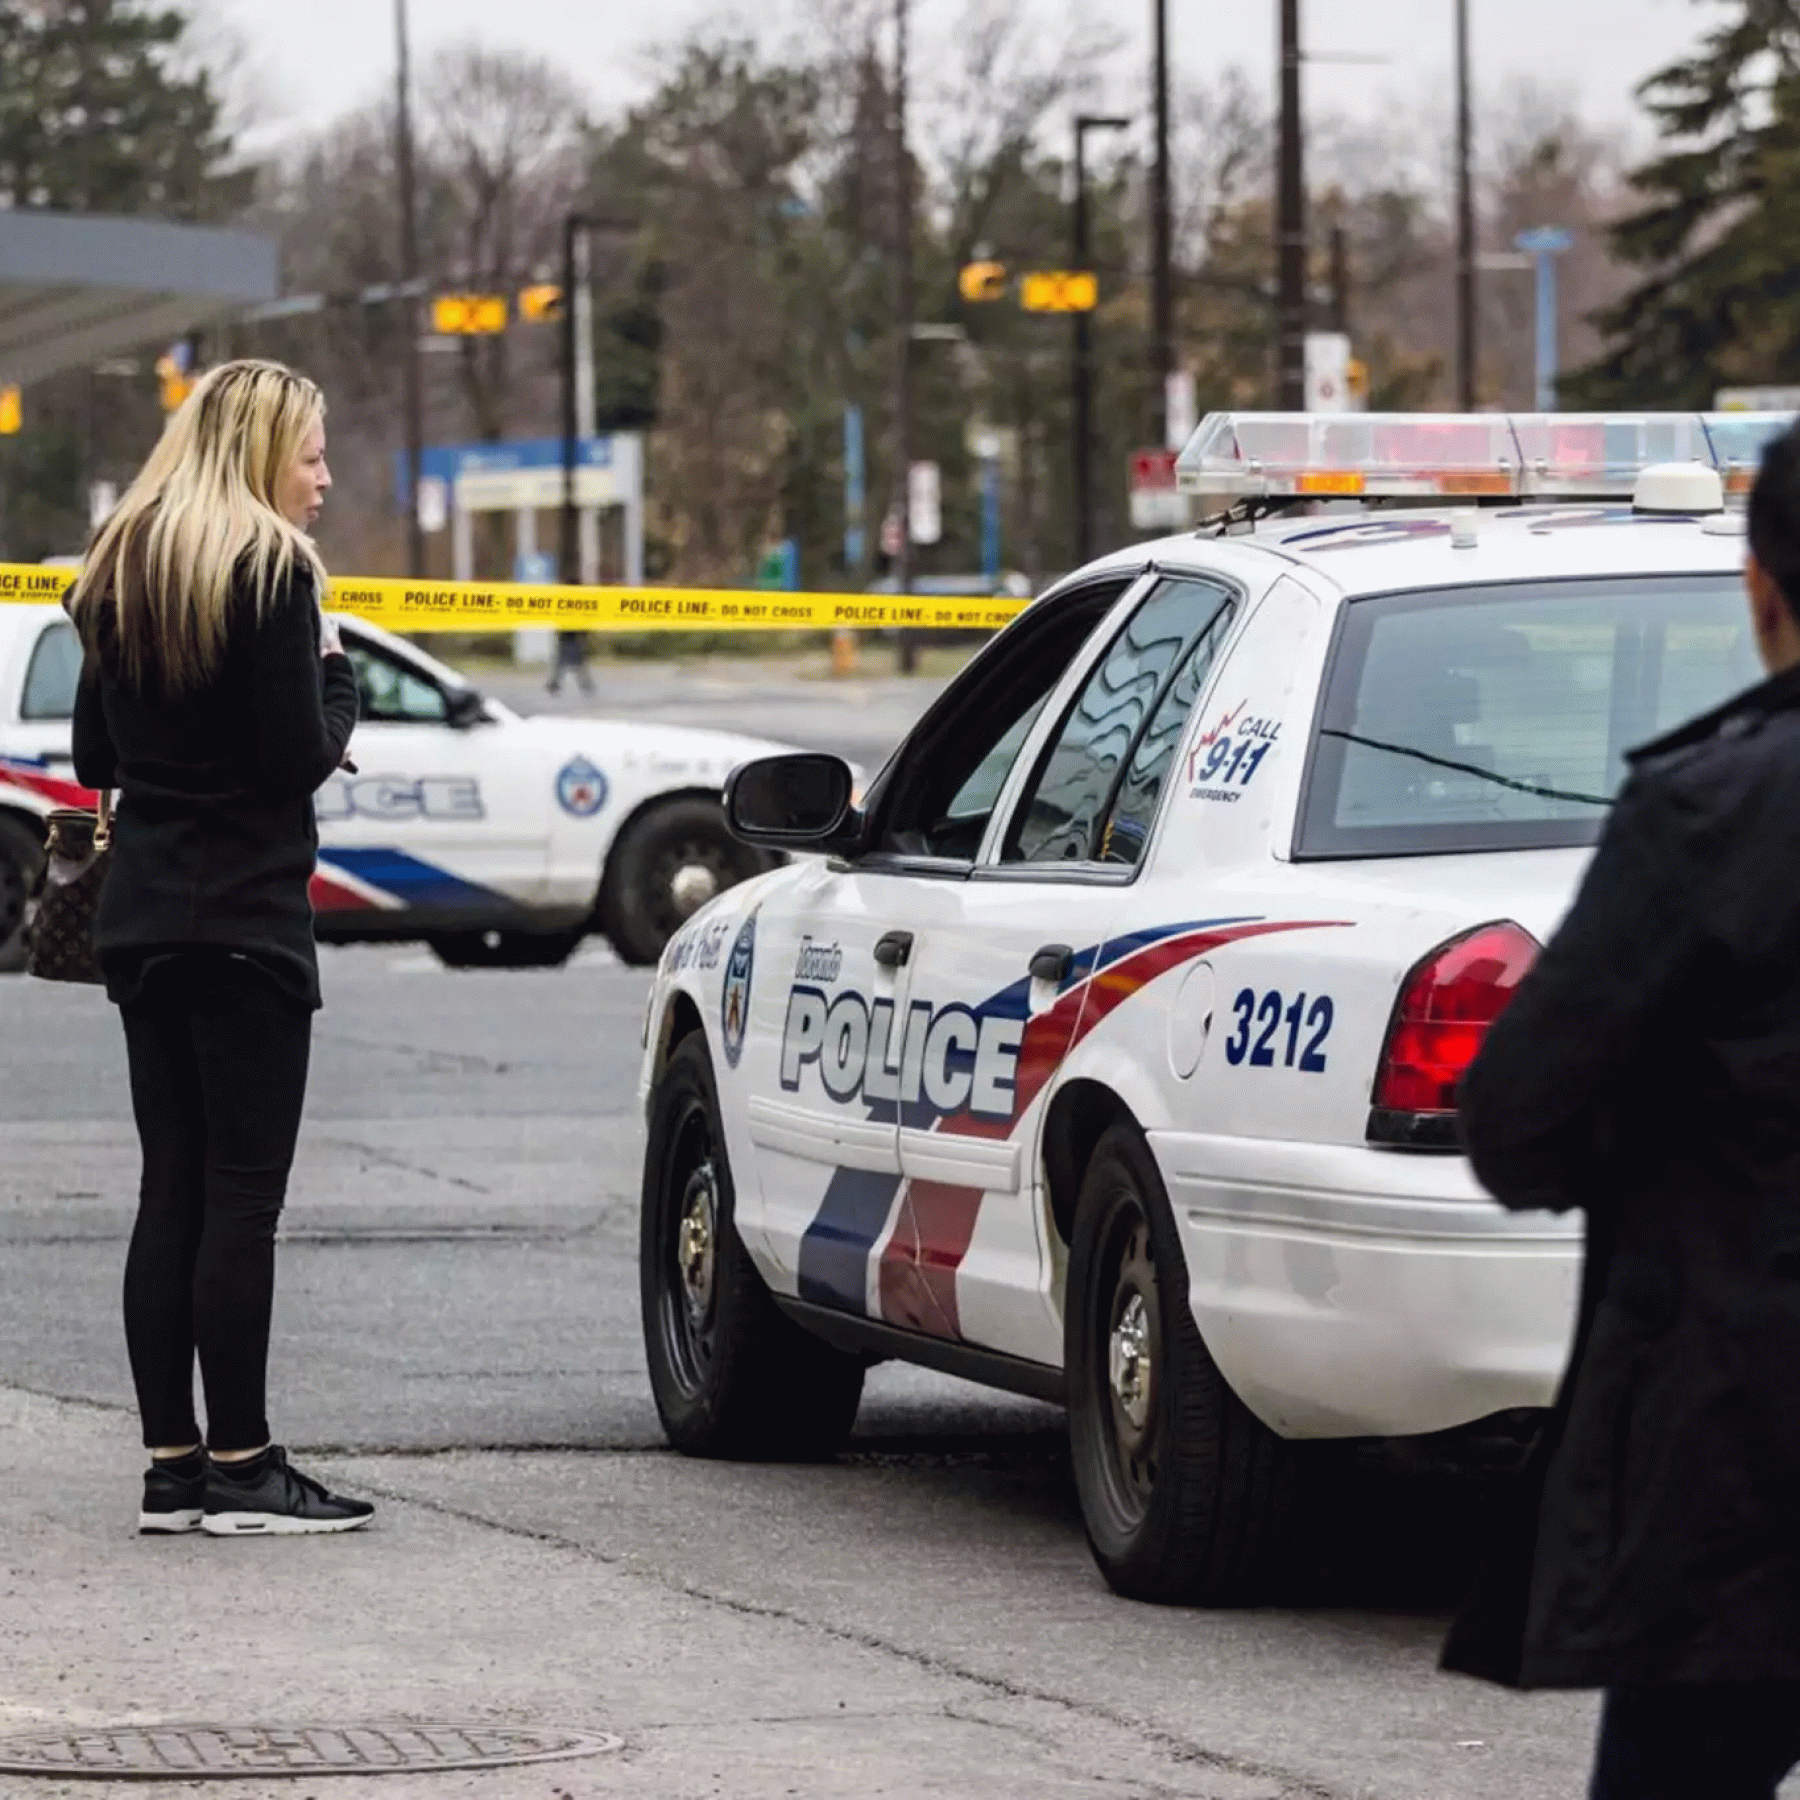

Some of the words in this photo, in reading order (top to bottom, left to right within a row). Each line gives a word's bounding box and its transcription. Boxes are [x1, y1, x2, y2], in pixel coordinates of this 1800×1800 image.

[341, 591, 383, 604] CROSS
[405, 591, 457, 606] POLICE
[506, 596, 523, 608] DO
[528, 597, 551, 609] NOT
[557, 599, 598, 610] CROSS
[620, 599, 671, 614] POLICE
[721, 604, 738, 616] DO
[743, 605, 766, 617] NOT
[772, 606, 812, 617] CROSS
[834, 606, 885, 619] POLICE
[935, 611, 951, 621] DO
[957, 612, 980, 622] NOT
[1237, 716, 1282, 740] CALL
[1225, 987, 1334, 1073] 3212
[780, 984, 1026, 1124] POLICE
